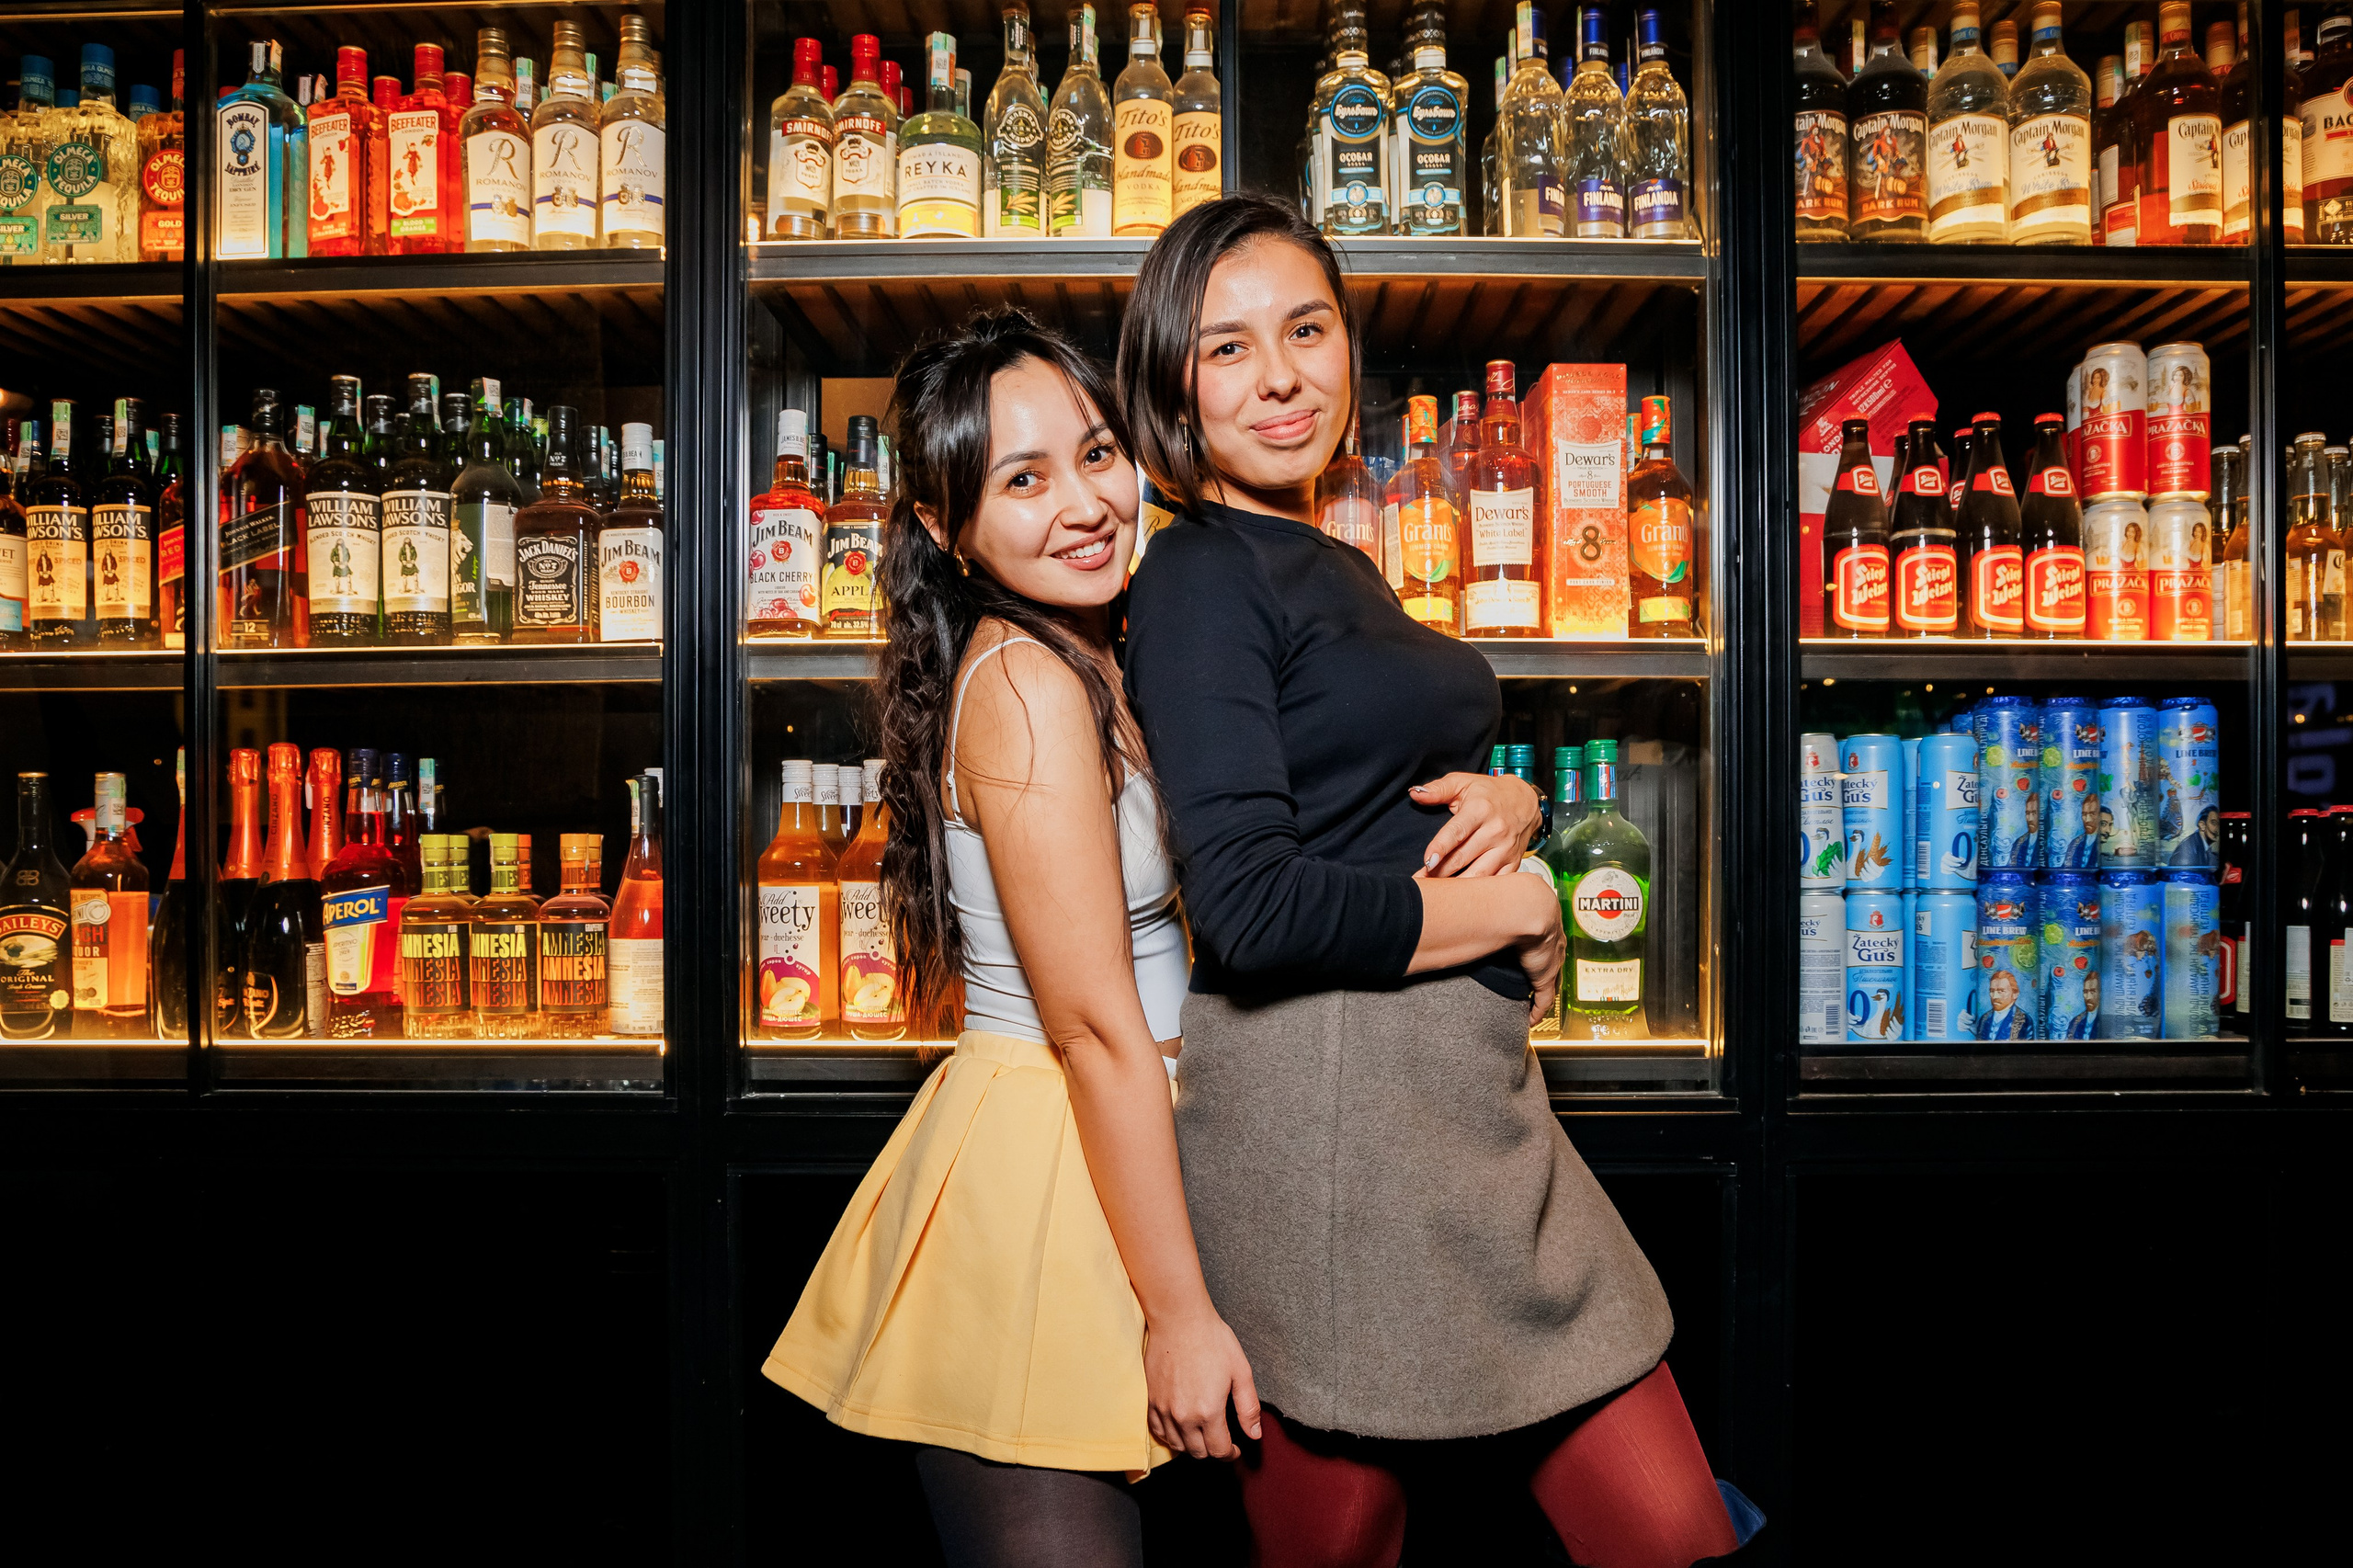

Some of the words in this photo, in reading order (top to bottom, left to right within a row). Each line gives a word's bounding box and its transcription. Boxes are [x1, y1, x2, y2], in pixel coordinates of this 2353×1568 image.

[1641, 47, 1665, 58] FINLANDIA
[226, 113, 260, 129] BOMBAY
[391, 116, 437, 133] BEEFEATER
[835, 118, 881, 134] SMIRNOFF
[1120, 108, 1167, 129] Tito's
[312, 119, 348, 139] BEEFEATER
[1175, 120, 1221, 142] Tito's
[1854, 116, 1887, 141] Captain
[1890, 114, 1924, 134] Morgan
[1961, 121, 1997, 138] Morgan
[2014, 124, 2049, 147] Captain
[2052, 120, 2085, 139] Morgan
[2178, 120, 2214, 139] Captain
[53, 146, 94, 164] OLMECA
[1339, 152, 1372, 163] ОСОБАЯ
[1416, 153, 1450, 165] ОСОБАЯ
[225, 161, 261, 176] SAPPHIRE
[607, 168, 658, 178] ROMANOV
[904, 161, 968, 178] REYKA
[540, 171, 592, 182] ROMANOV
[53, 176, 96, 194] TEQUILA
[476, 177, 527, 192] ROMANOV
[1126, 183, 1160, 191] VODKA
[1634, 191, 1679, 211] FINLANDIA
[1862, 200, 1893, 212] DARK
[1896, 199, 1918, 208] RUM
[158, 220, 182, 228] GOLD
[1565, 453, 1615, 466] Dewar's
[1587, 471, 1593, 480] 8
[1574, 489, 1607, 497] SMOOTH
[311, 500, 373, 515] WILLIAM
[383, 498, 441, 512] WILLIAM
[308, 514, 378, 529] LAWSON'S
[1476, 506, 1529, 522] Dewar's
[225, 524, 249, 538] JOHNNIE
[249, 516, 275, 527] WALKER
[753, 525, 776, 548] JIM
[779, 520, 813, 549] BEAM
[1404, 523, 1452, 542] Grant's
[310, 532, 329, 545] BLENDED
[357, 534, 377, 545] WHISKY
[1581, 526, 1601, 561] 8
[161, 545, 182, 558] RED
[518, 544, 540, 562] JACK
[541, 540, 578, 562] DANIEL'S
[601, 545, 622, 568] JIM
[625, 540, 661, 568] BEAM
[828, 537, 850, 559] JIM
[54, 557, 82, 565] SPICED
[119, 556, 146, 564] SPICED
[750, 572, 776, 584] BLACK
[779, 572, 813, 583] CHERRY
[1915, 565, 1950, 588] Stiegl
[2045, 564, 2080, 589] Stiegl
[529, 581, 567, 590] Tennessee
[606, 595, 655, 608] BOURBON
[244, 622, 256, 633] 12
[2177, 750, 2197, 758] LINE
[762, 891, 792, 905] Add
[846, 888, 875, 901] Add
[323, 898, 380, 926] APEROL
[1580, 898, 1638, 911] MARTINI
[759, 900, 816, 931] weety
[0, 917, 62, 934] AILEYS
[1983, 926, 2001, 935] LINE
[2003, 926, 2027, 935] BREW
[543, 932, 606, 957] AMNESIA
[774, 932, 804, 942] duchesse
[1852, 934, 1899, 950] Žatecký
[1858, 949, 1896, 962] Gus
[543, 956, 606, 981] AMNESIA
[1, 975, 54, 983] ORIGINAL
[543, 980, 606, 1006] AMNESIA
